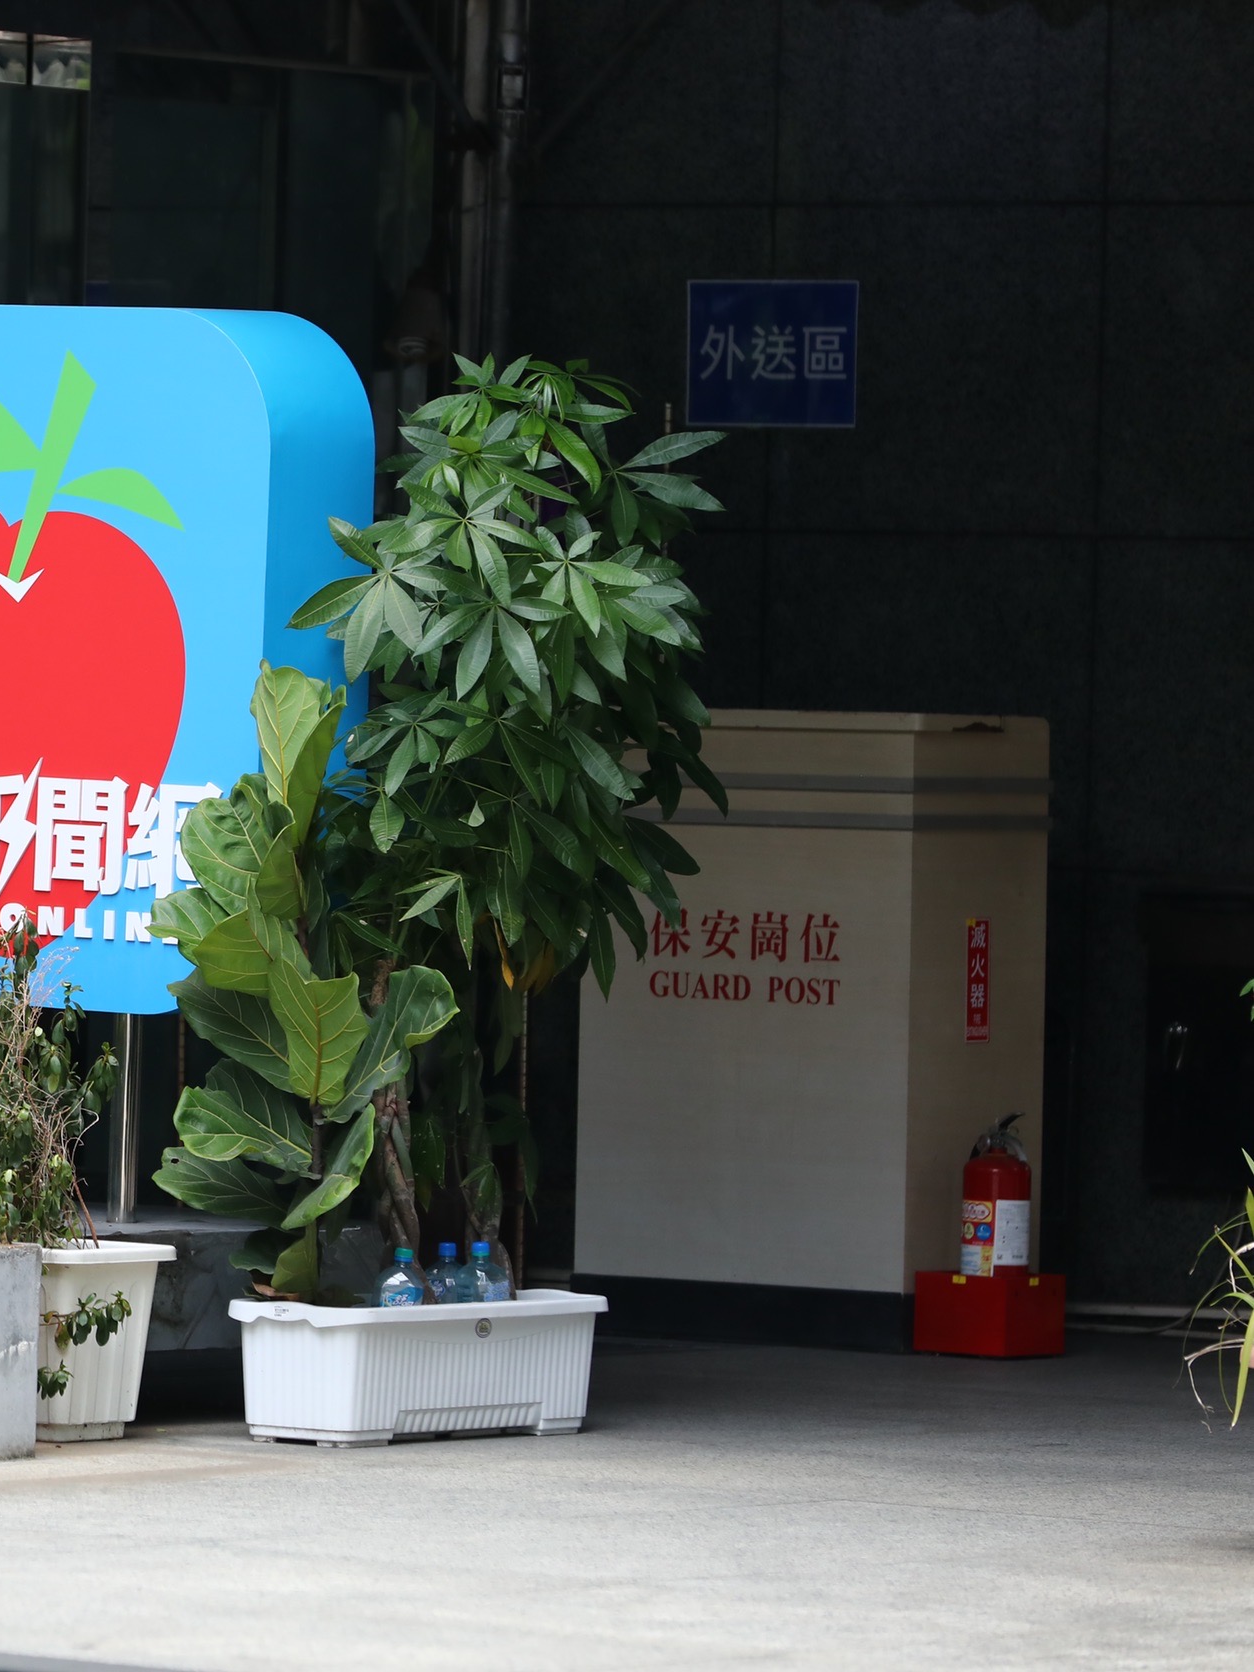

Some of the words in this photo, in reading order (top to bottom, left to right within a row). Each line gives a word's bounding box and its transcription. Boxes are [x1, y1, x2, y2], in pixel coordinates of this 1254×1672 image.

[700, 325, 847, 380] 外送區
[0, 903, 179, 945] ONLIN
[650, 908, 841, 963] 保安崗位
[649, 970, 751, 1001] GUARD
[768, 976, 841, 1006] POST
[970, 923, 986, 1008] 滅火器
